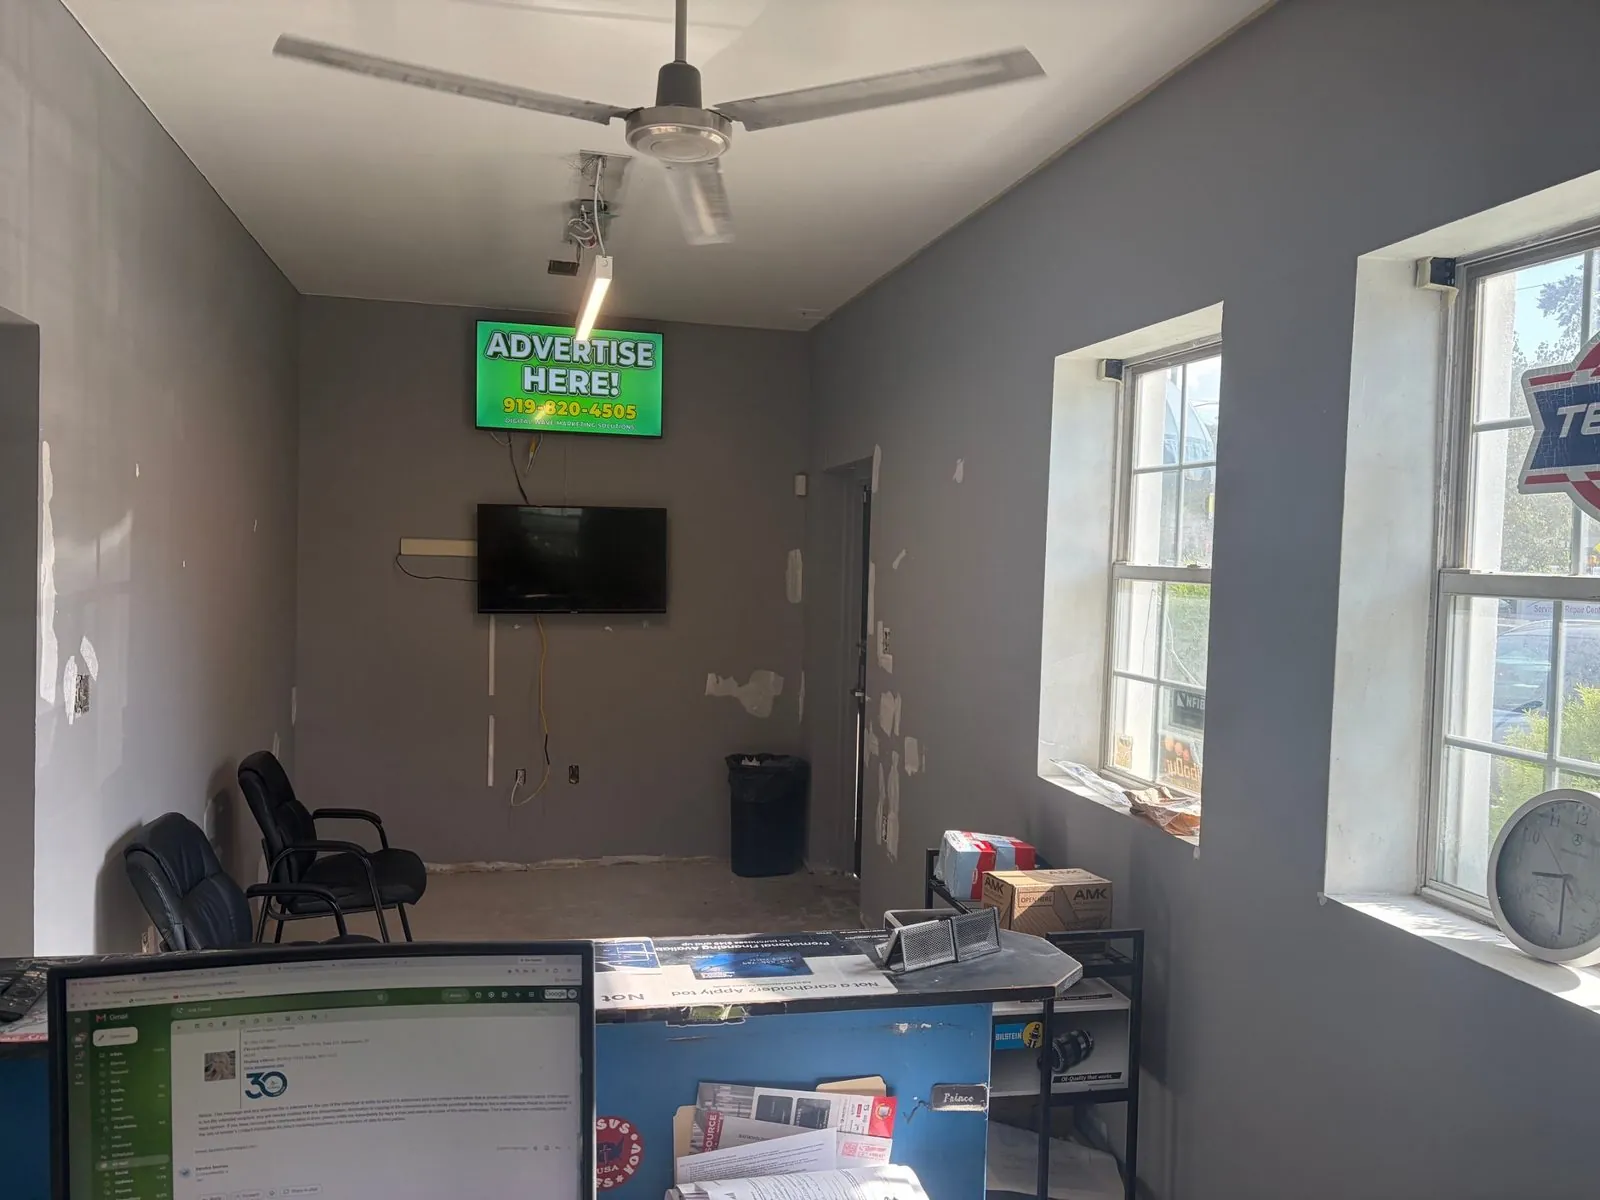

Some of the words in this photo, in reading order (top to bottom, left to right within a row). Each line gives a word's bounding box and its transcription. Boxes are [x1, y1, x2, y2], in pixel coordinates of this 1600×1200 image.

[485, 331, 654, 368] ADVERTISE
[522, 366, 621, 398] HERE!
[503, 397, 637, 420] 919-820-4505
[597, 423, 635, 431] SOLUTIONS
[984, 876, 1004, 895] AMK
[1020, 896, 1037, 904] OPEN
[1073, 888, 1108, 901] AMK
[544, 989, 567, 999] Google
[700, 986, 744, 996] Apply
[748, 983, 838, 994] cardholder?
[601, 993, 644, 1002] Not
[109, 1013, 128, 1021] Gmail
[995, 1031, 1022, 1041] BILSTEIN
[244, 1070, 288, 1099] 30
[943, 1091, 975, 1104] Prince
[596, 1164, 620, 1175] USA
